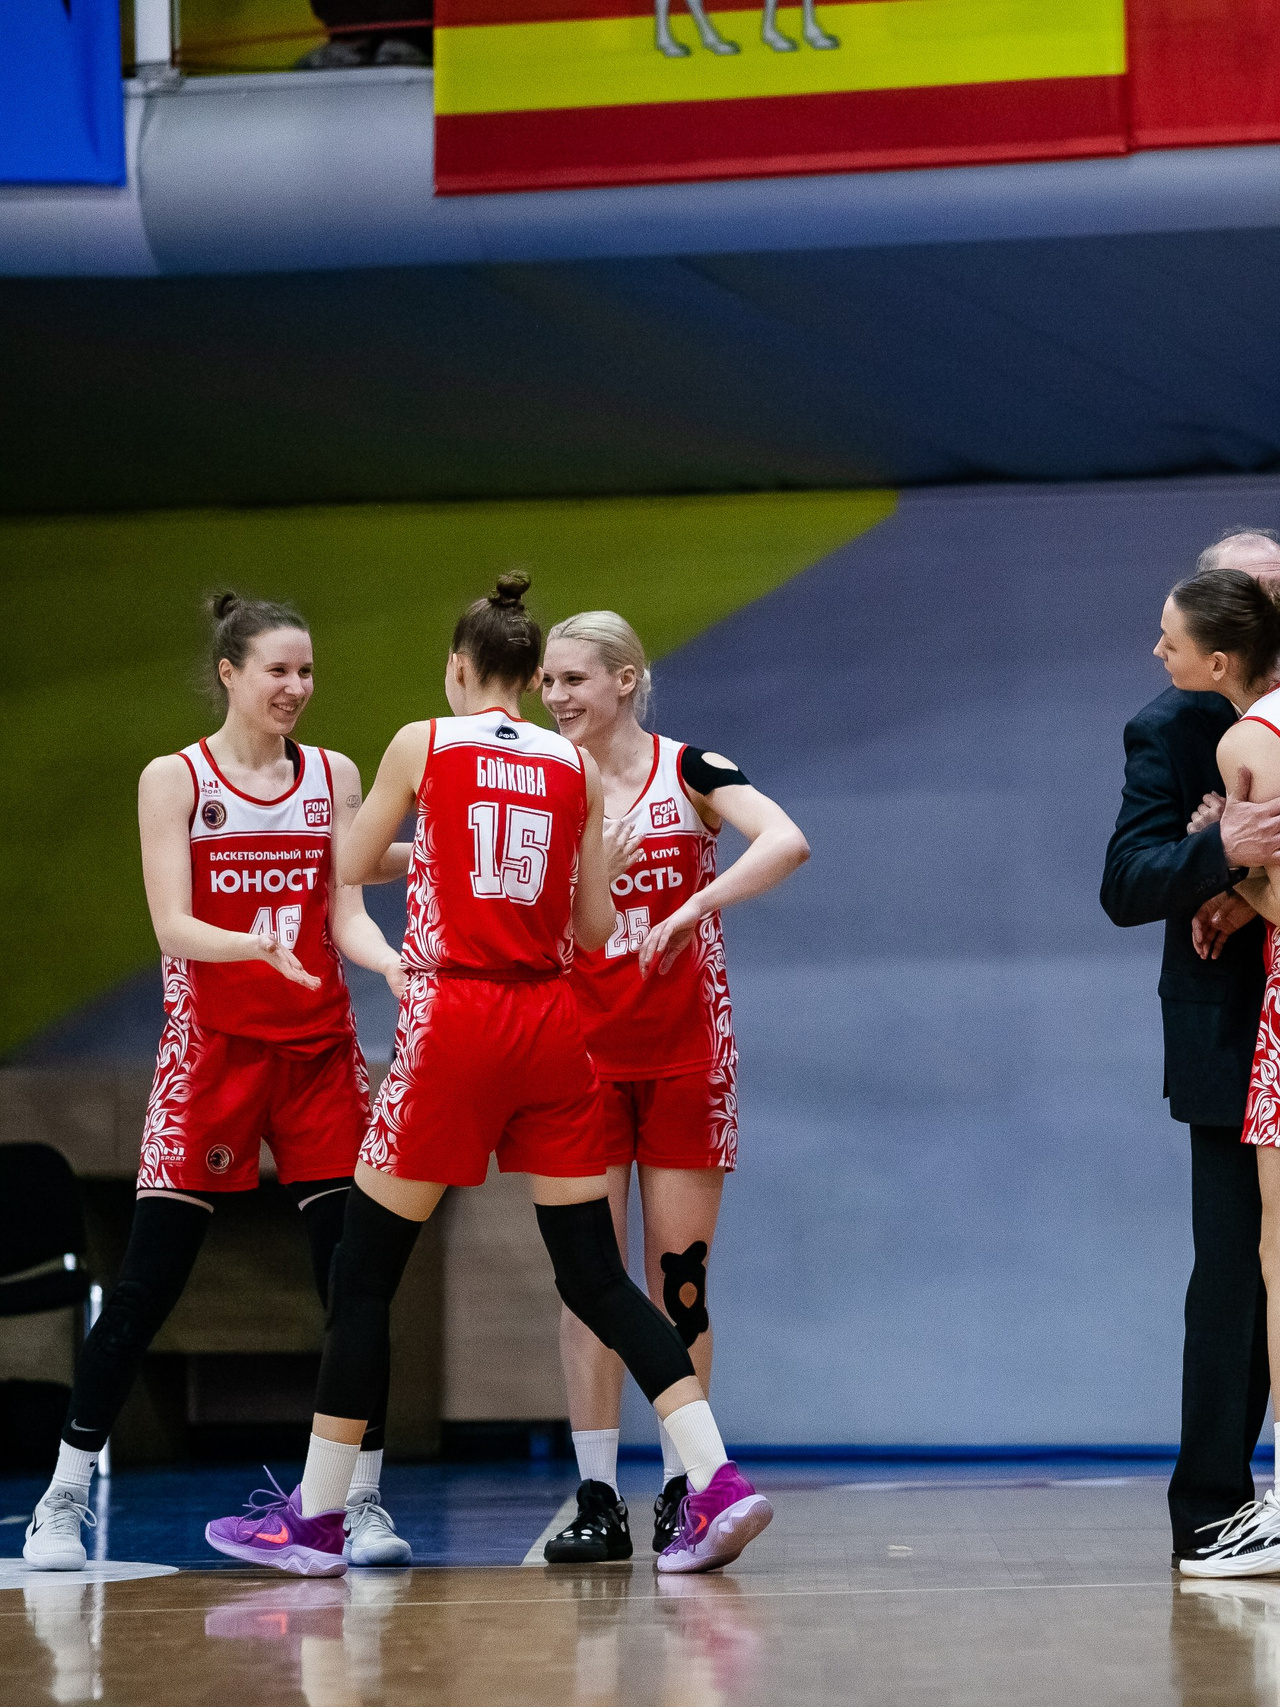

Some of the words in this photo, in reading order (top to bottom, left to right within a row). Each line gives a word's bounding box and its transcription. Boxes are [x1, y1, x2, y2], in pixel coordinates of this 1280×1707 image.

[476, 756, 547, 797] БОЙКОВА
[305, 801, 328, 813] FON
[307, 811, 330, 824] BET
[652, 799, 675, 815] FON
[654, 809, 677, 826] BET
[209, 848, 301, 862] БАСКЕТБОЛЬНЫЙ
[305, 848, 325, 860] КЛУ
[468, 800, 553, 907] 15
[651, 846, 681, 860] КЛУБ
[210, 866, 320, 894] ЮНОСТ
[609, 865, 684, 897] ОСТЬ
[248, 903, 302, 953] 46
[604, 905, 651, 960] 25
